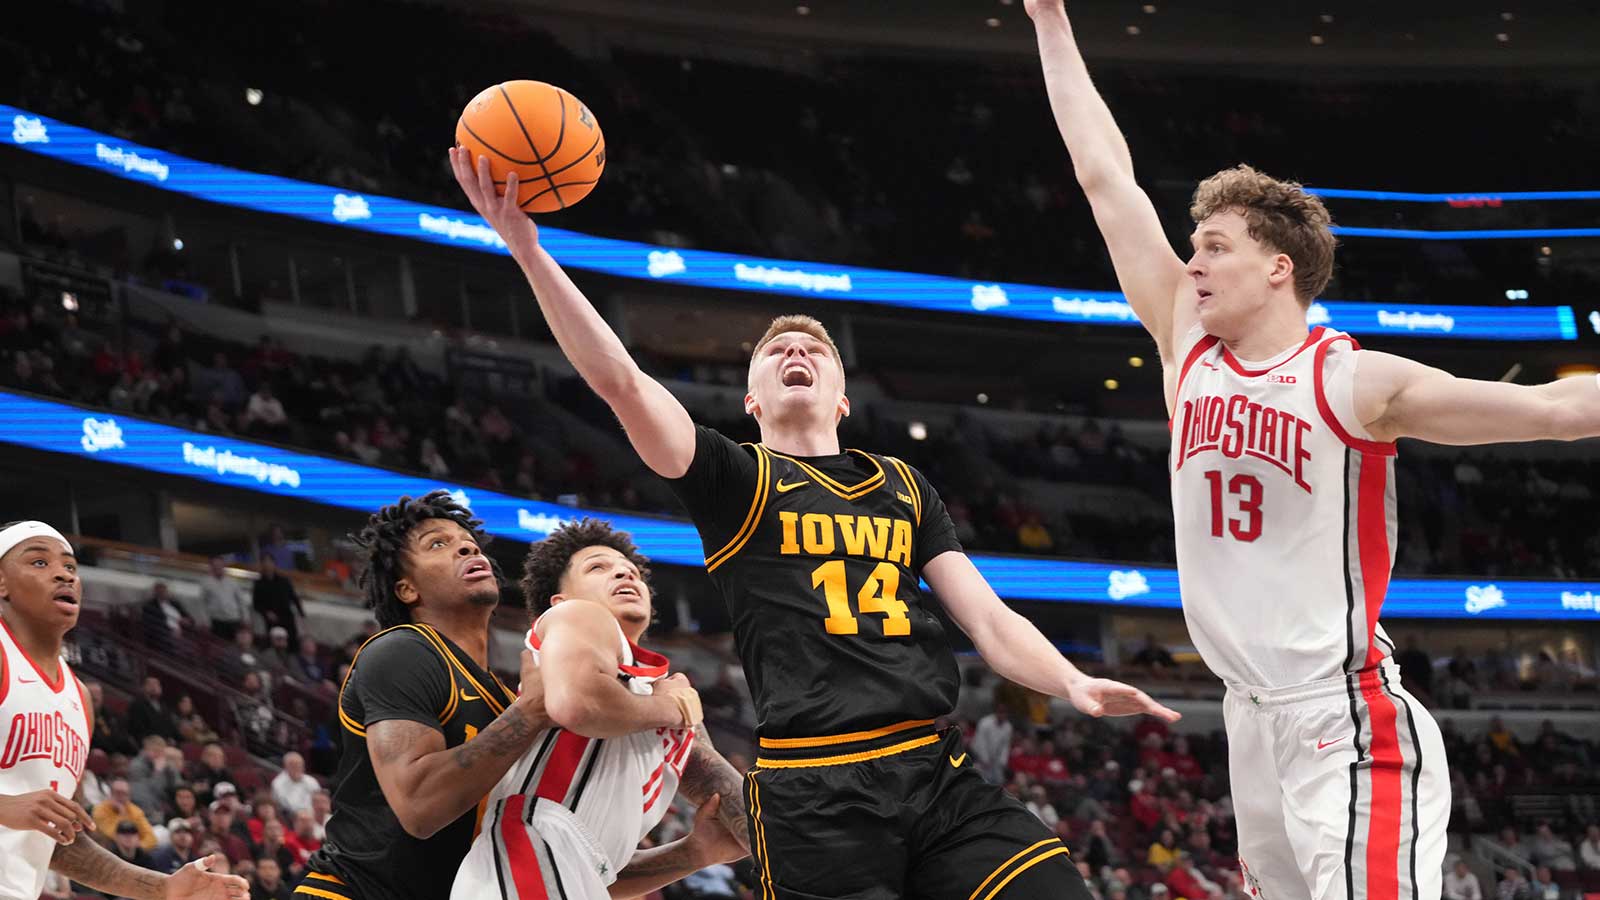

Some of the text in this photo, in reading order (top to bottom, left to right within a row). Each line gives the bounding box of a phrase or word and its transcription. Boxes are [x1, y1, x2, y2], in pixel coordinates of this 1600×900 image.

[779, 511, 913, 568] IOWA
[1204, 470, 1264, 543] 13
[811, 560, 911, 636] 14
